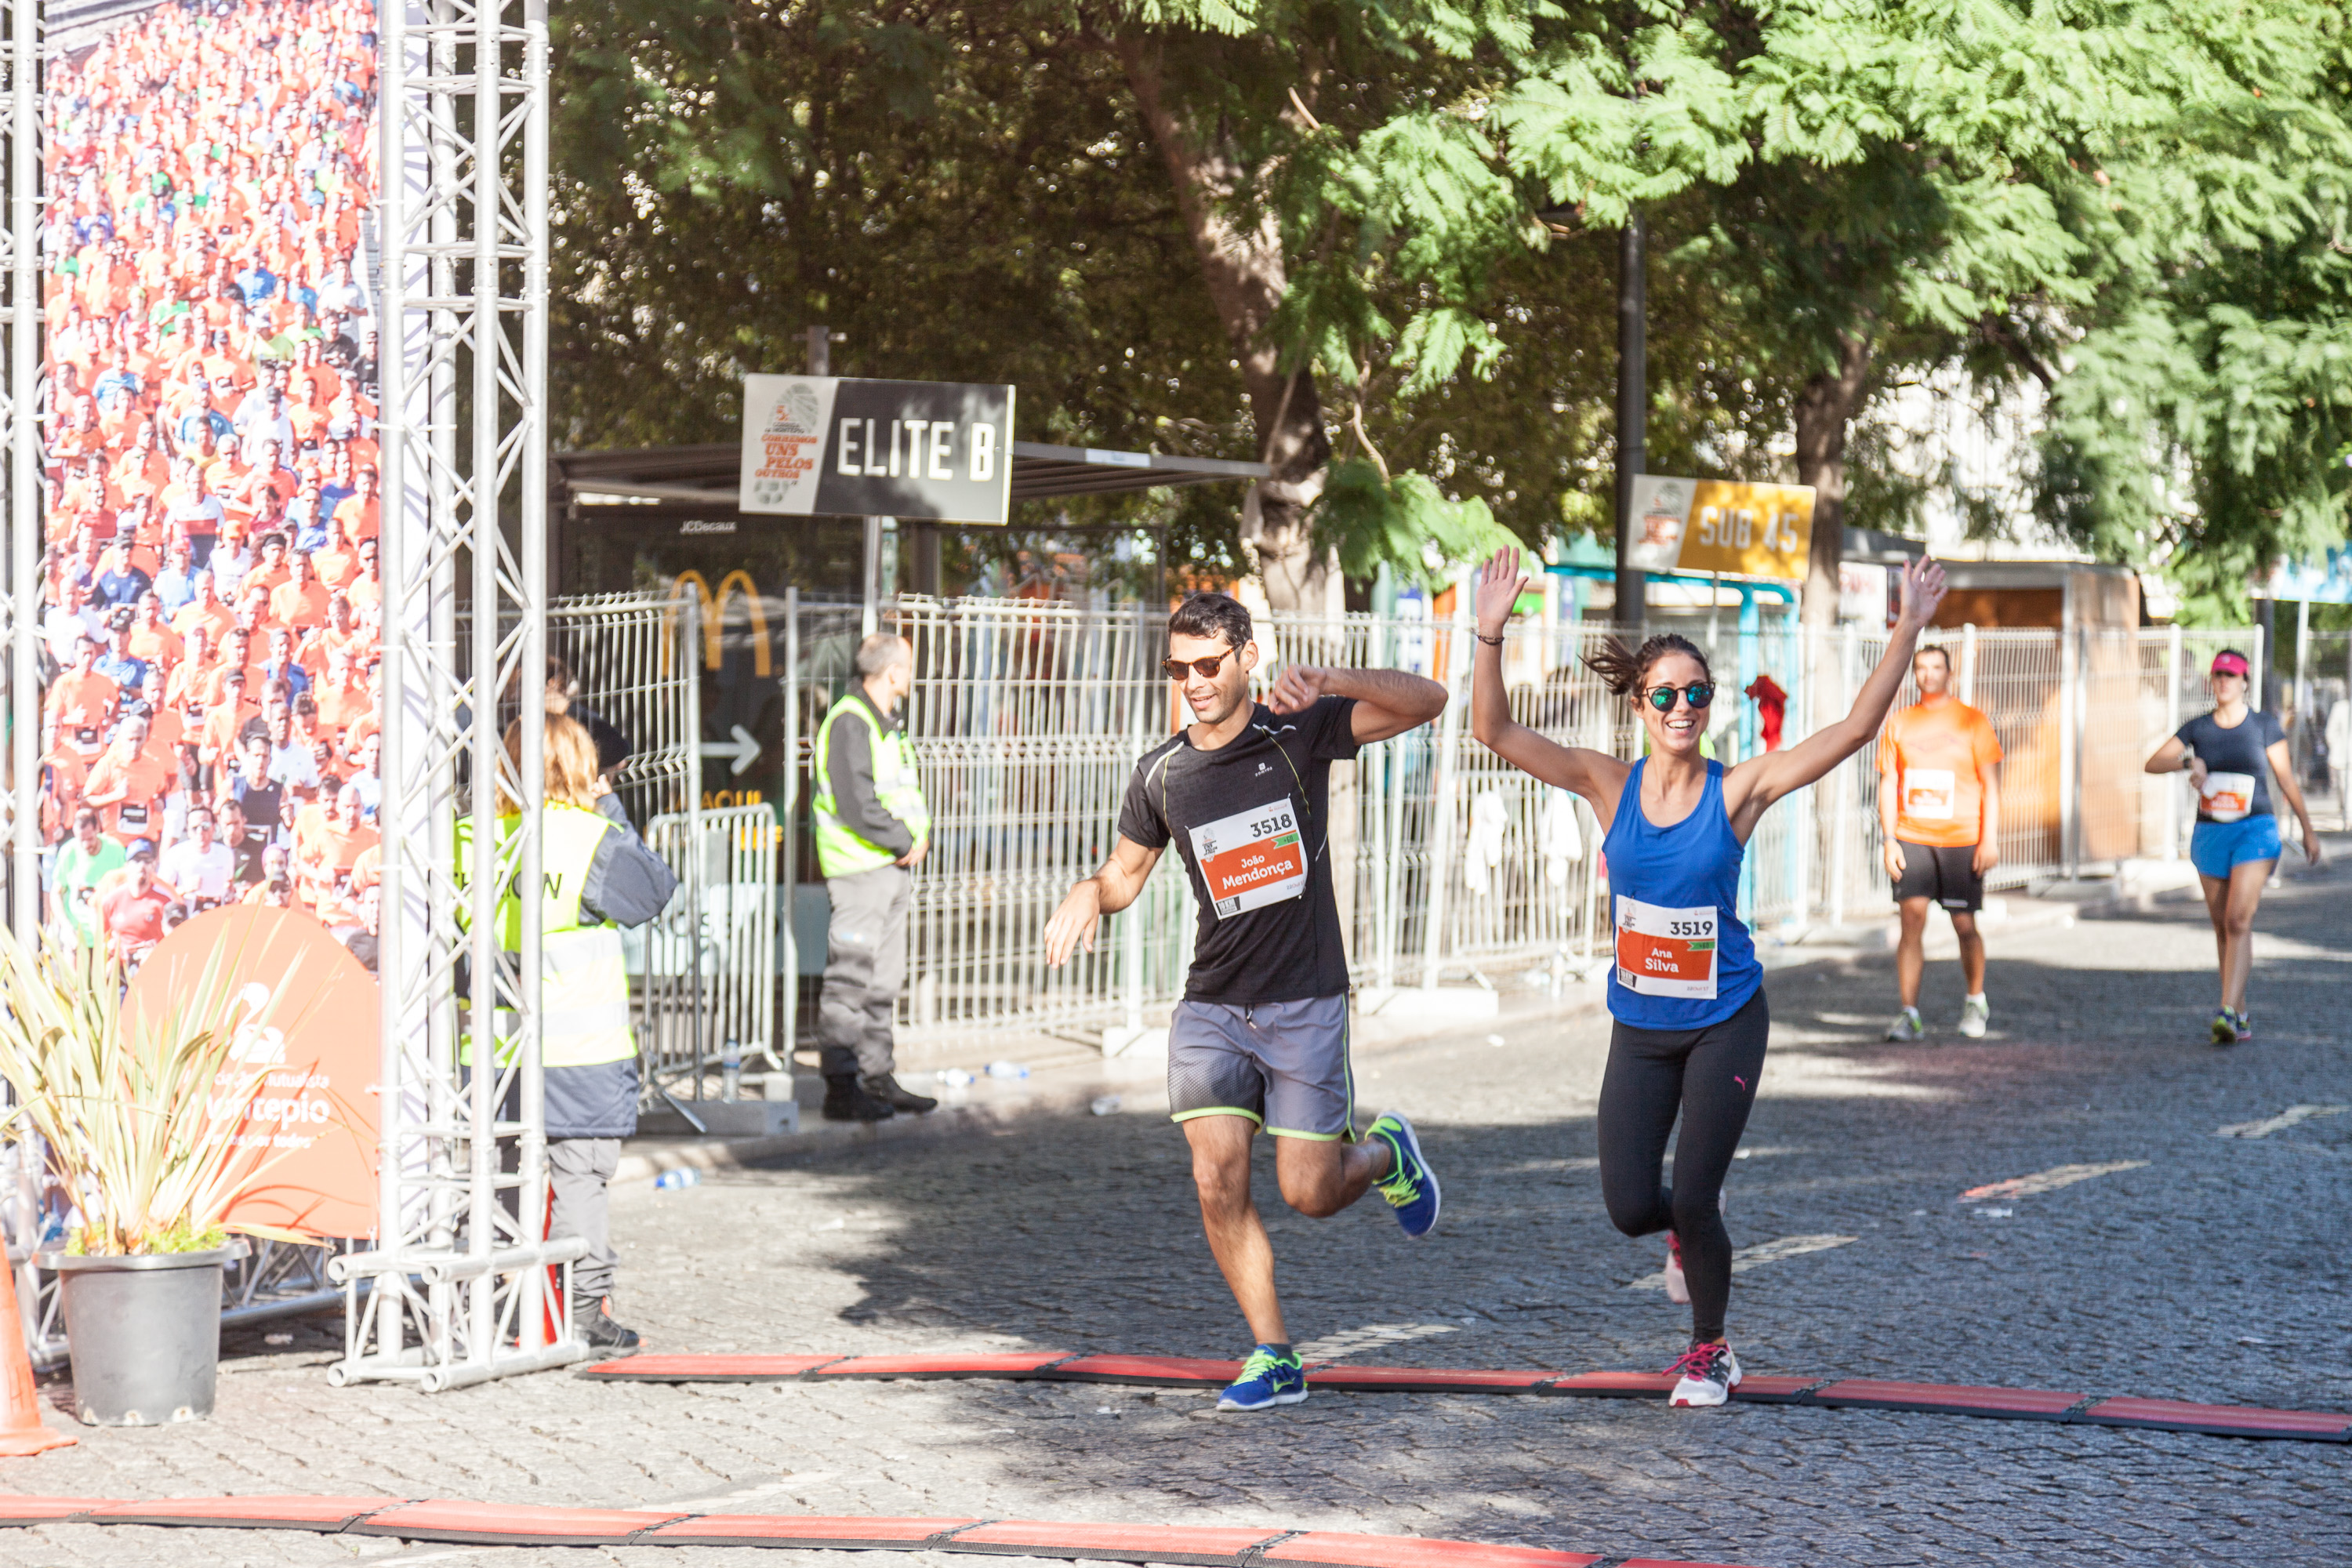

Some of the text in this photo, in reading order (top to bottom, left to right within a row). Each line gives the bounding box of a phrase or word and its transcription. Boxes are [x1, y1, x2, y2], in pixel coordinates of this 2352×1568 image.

[765, 442, 798, 456] UNS
[837, 417, 996, 482] ELITE B
[764, 456, 814, 470] PELOS
[755, 469, 800, 479] OUTROS
[679, 520, 737, 535] JCDecaux
[1699, 506, 1753, 549] SUB
[1763, 512, 1799, 554] 45
[1250, 813, 1293, 838] 3518
[1241, 855, 1265, 869] João
[1221, 859, 1294, 891] Mendonça
[1670, 920, 1714, 936] 3519
[1651, 947, 1673, 959] Ana
[1645, 957, 1679, 973] Silva
